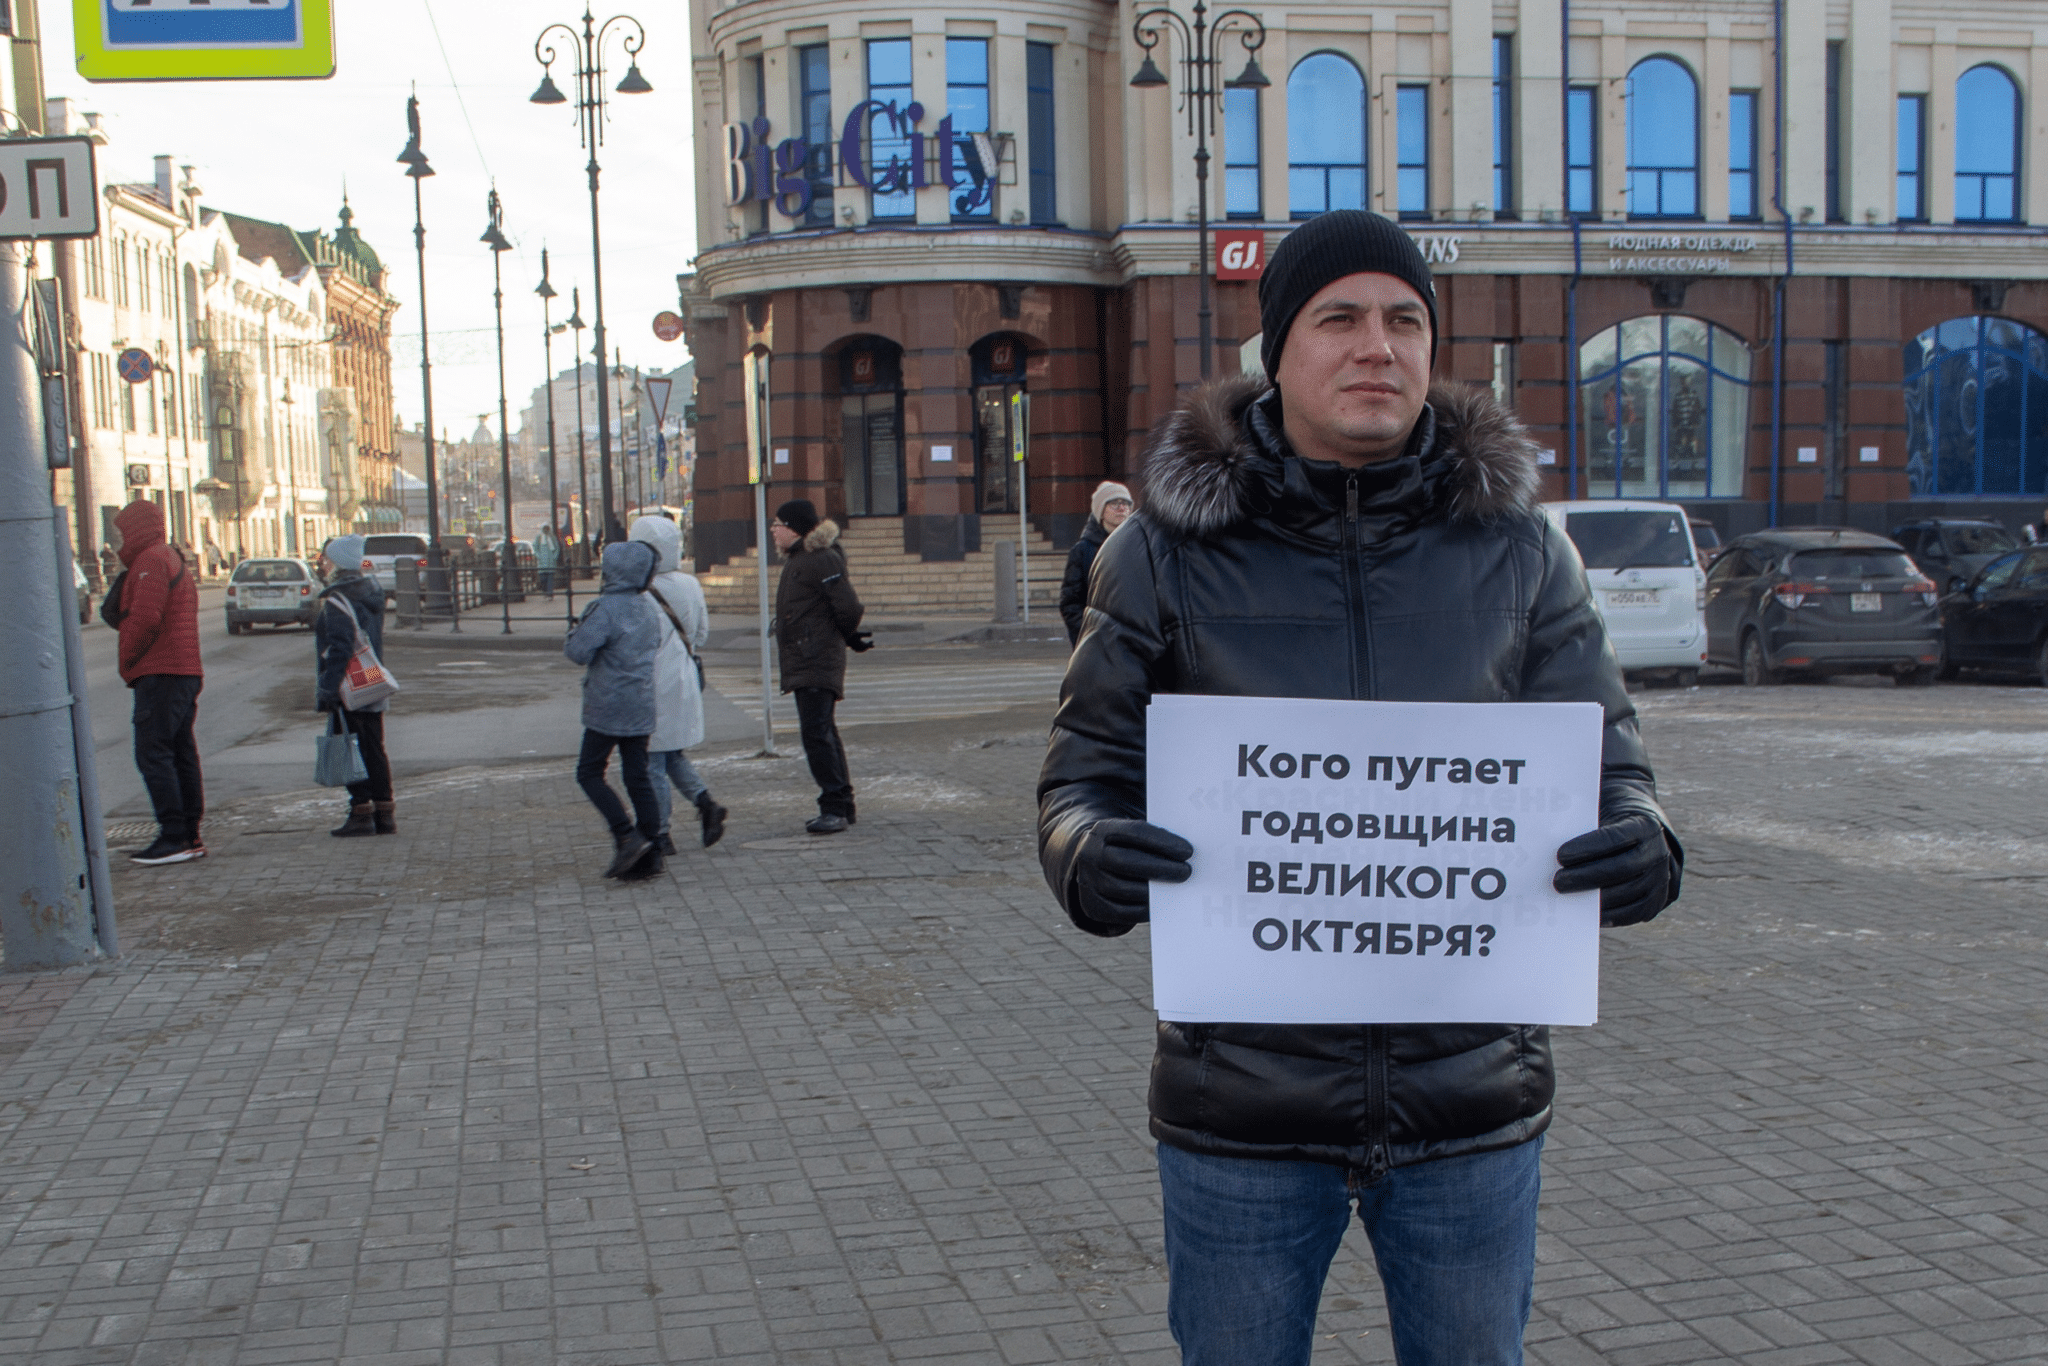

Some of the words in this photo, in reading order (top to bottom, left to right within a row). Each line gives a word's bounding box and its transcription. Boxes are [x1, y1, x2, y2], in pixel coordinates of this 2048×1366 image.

[722, 115, 812, 218] Big
[841, 99, 1012, 215] City
[0, 157, 69, 219] П
[1608, 235, 1681, 251] МОДНАЯ
[1685, 236, 1757, 252] ОДЕЖДА
[1608, 256, 1622, 270] И
[1626, 257, 1730, 271] АКСЕССУАРЫ
[855, 357, 872, 376] GJ
[994, 347, 1010, 365] GJ
[1238, 744, 1350, 779] Кого
[1368, 756, 1525, 790] пугает
[1242, 811, 1516, 847] годовщина
[1248, 861, 1507, 900] ВЕЛИКОГО
[1253, 918, 1497, 957] ОКТЯБРЯ?
